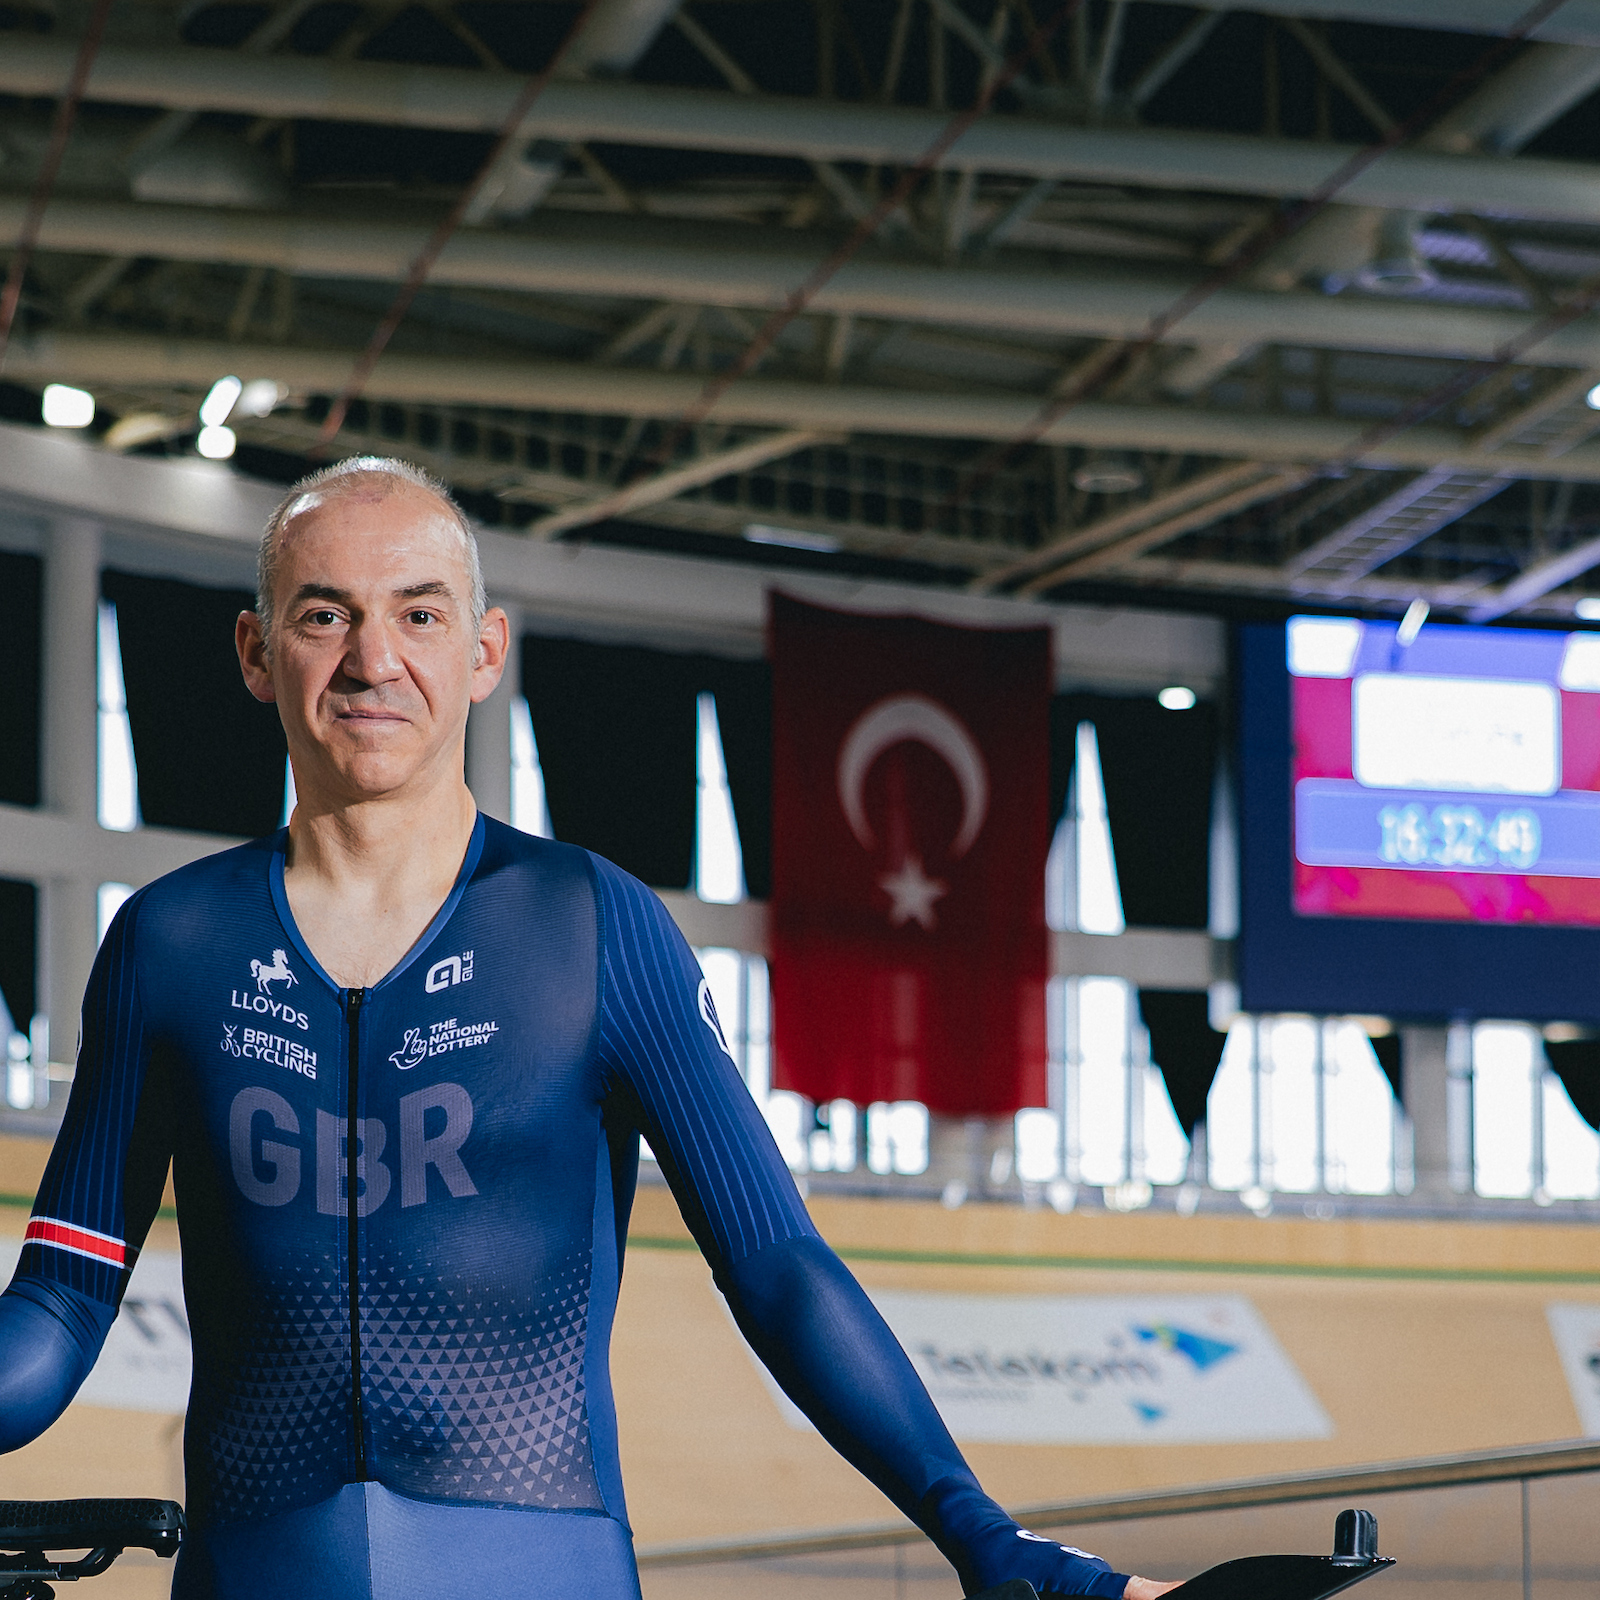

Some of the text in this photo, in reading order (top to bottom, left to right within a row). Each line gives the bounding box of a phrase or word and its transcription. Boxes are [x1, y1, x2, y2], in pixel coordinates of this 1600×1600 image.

[231, 990, 310, 1031] LLOYDS
[429, 1018, 458, 1034] THE
[243, 1028, 317, 1066] BRITISH
[428, 1034, 492, 1057] LOTTERY
[429, 1021, 499, 1046] NATIONAL
[242, 1044, 317, 1080] CYCLING
[229, 1082, 479, 1218] GBR
